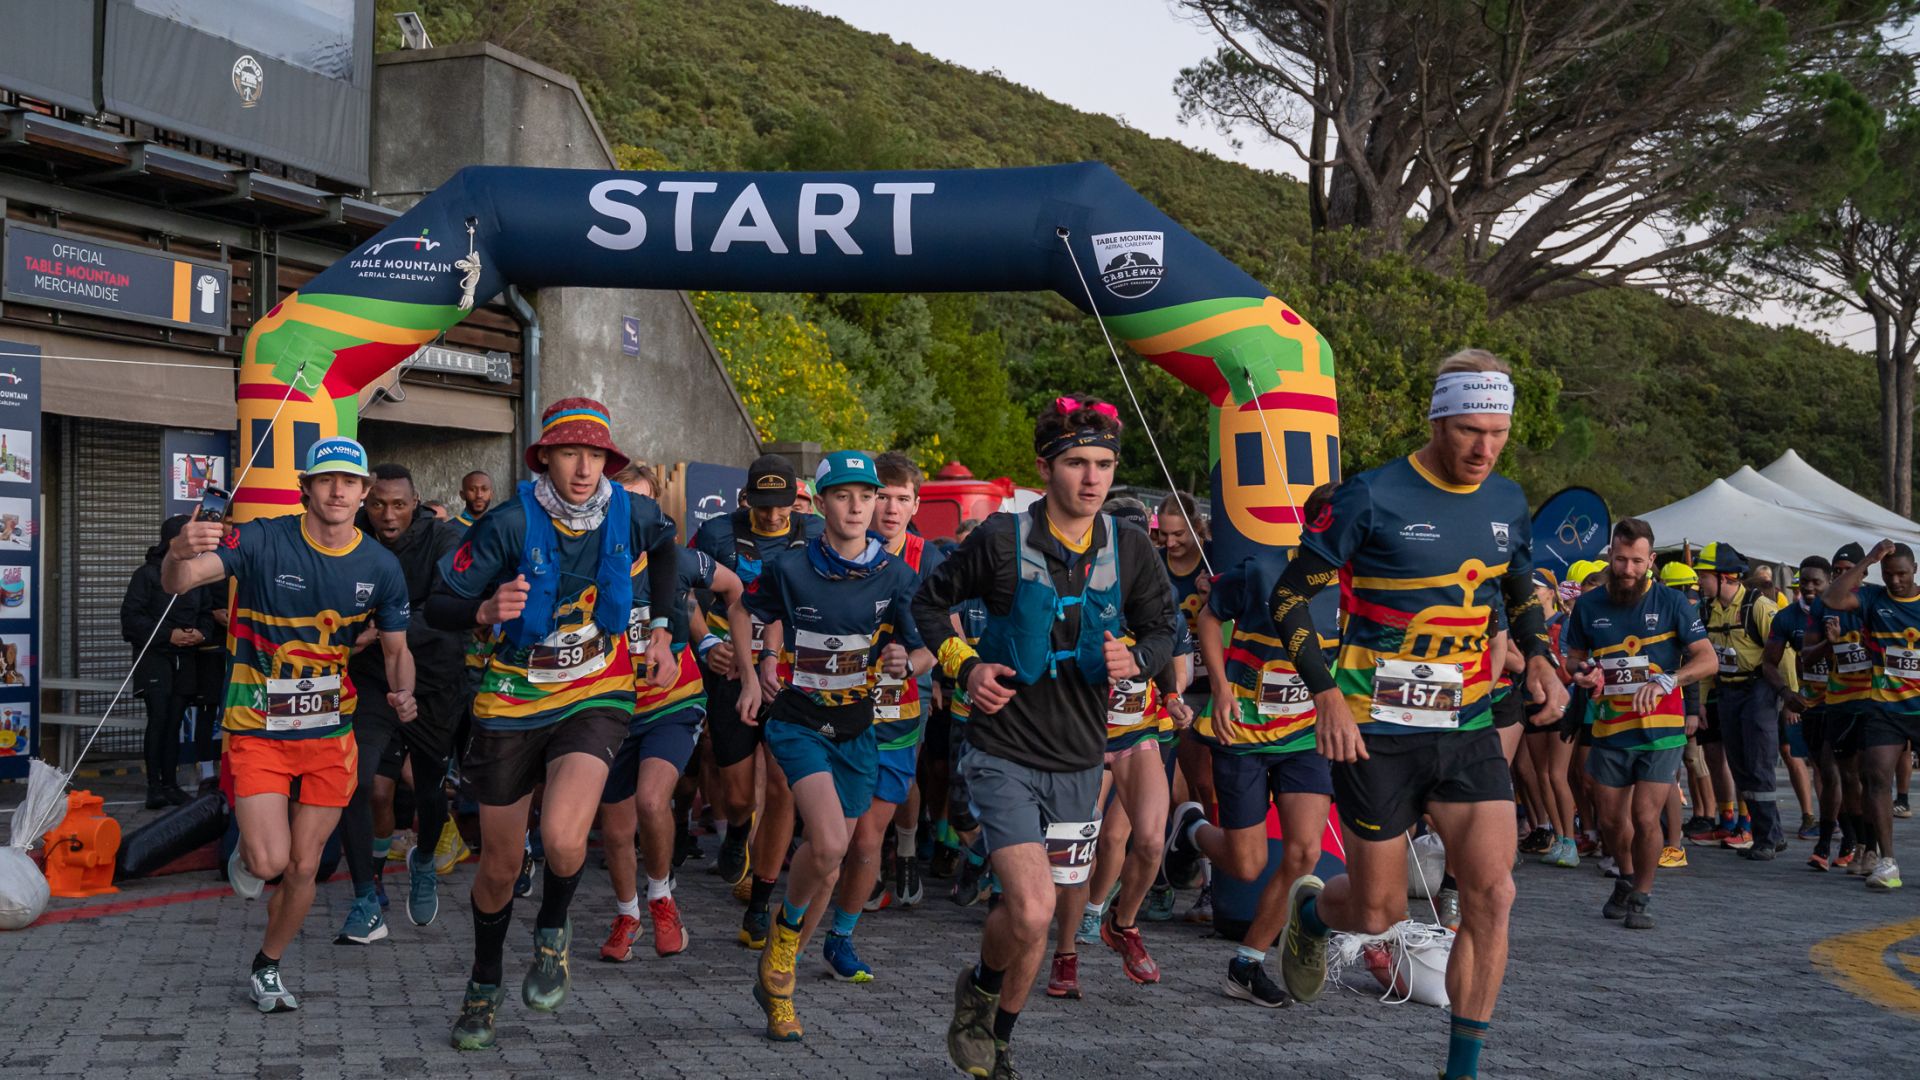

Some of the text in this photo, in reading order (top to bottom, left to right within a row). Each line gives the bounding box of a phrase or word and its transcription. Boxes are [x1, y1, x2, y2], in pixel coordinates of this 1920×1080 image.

[586, 179, 936, 256] START
[1096, 234, 1161, 246] TABLE MOUNTAIN
[1124, 240, 1154, 248] CABLEWAY
[53, 244, 106, 267] OFFICIAL
[24, 256, 130, 287] TABLE MOUNTAIN
[350, 260, 451, 273] TABLE MOUNTAIN
[358, 271, 435, 282] AERIAL CABLEWAY
[1102, 268, 1165, 283] CABLEWAY
[34, 274, 119, 302] MERCHANDISE
[1463, 383, 1508, 391] SUUNTO
[0, 390, 28, 400] OUNTAIN
[1463, 402, 1509, 411] SUUNTO
[1582, 522, 1599, 544] YEARS
[558, 646, 584, 668] 59
[825, 653, 839, 673] 4
[1845, 651, 1866, 663] 136
[1896, 658, 1919, 670] 135
[1616, 669, 1633, 683] 23
[1280, 686, 1309, 702] 126
[1398, 682, 1442, 707] 157
[287, 693, 322, 714] 150
